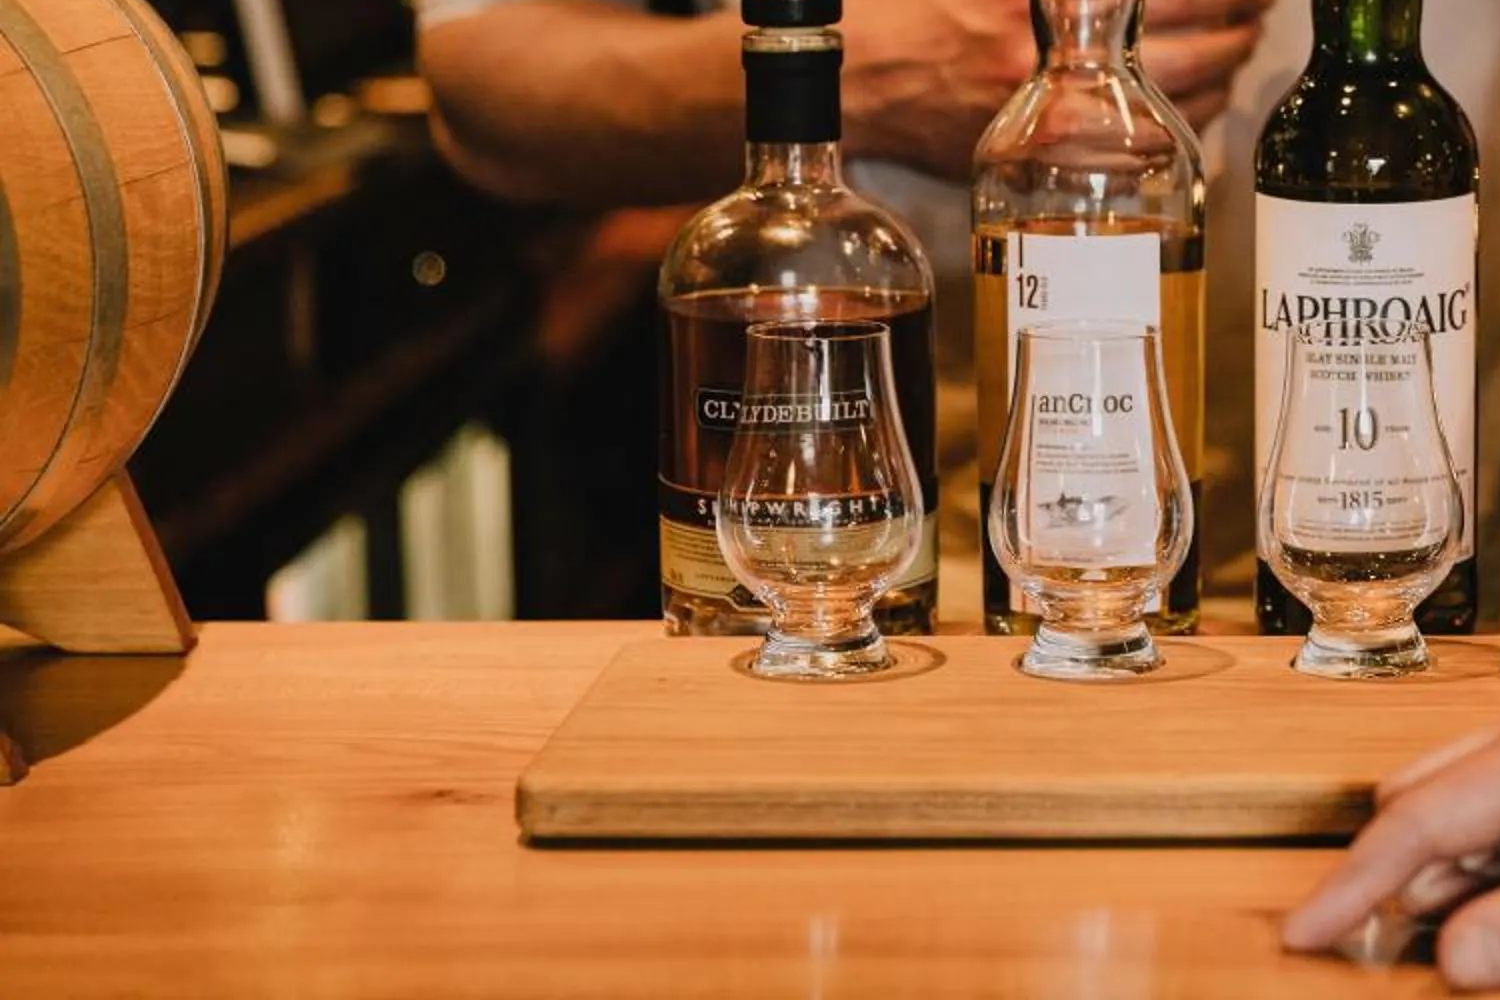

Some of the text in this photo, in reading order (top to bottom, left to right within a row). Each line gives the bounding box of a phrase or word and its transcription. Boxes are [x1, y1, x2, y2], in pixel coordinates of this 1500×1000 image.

[1016, 273, 1039, 309] 12
[1262, 286, 1468, 343] LAPHROAIG
[1338, 407, 1378, 451] 10
[697, 496, 879, 517] SHPWRGHT
[1340, 491, 1384, 511] 1815
